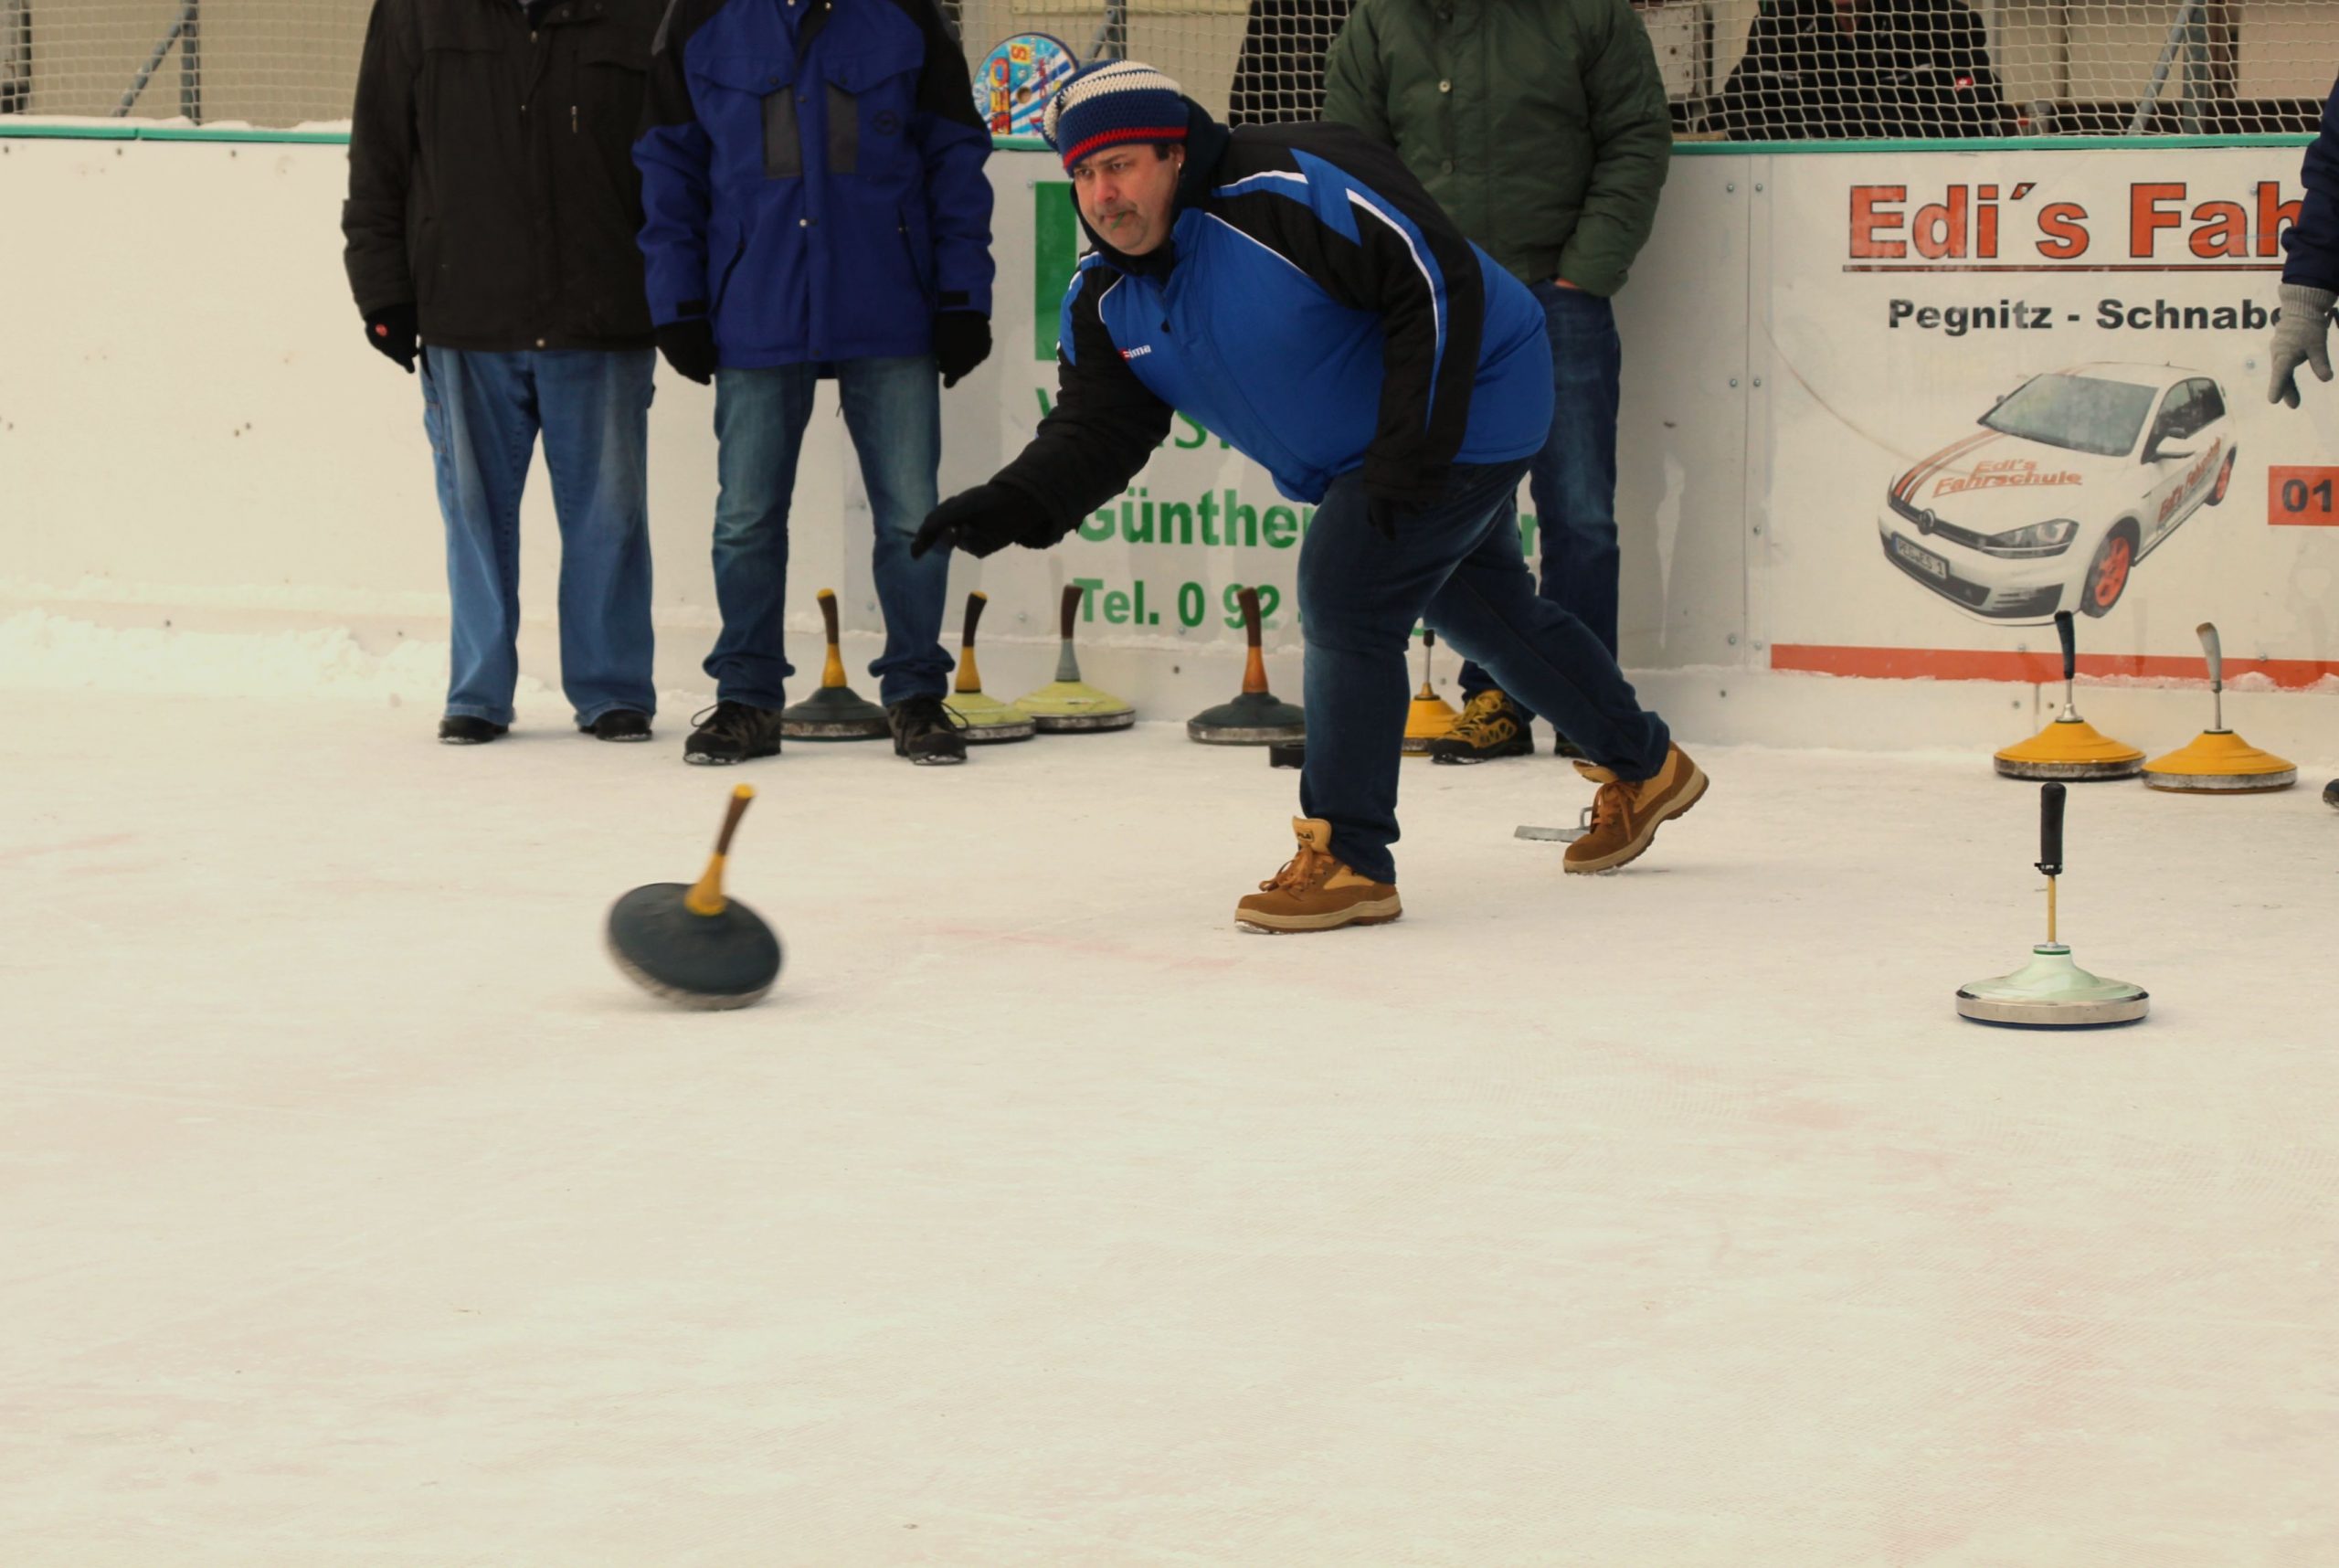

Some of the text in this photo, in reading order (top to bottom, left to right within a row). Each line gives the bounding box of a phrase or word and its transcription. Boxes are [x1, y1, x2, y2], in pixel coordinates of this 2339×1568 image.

[1889, 299, 2052, 336] Pegnitz
[1932, 470, 2083, 498] Fahrschule
[2281, 479, 2333, 513] 01
[1073, 577, 1159, 625] Tel.
[1178, 582, 1205, 627] 0
